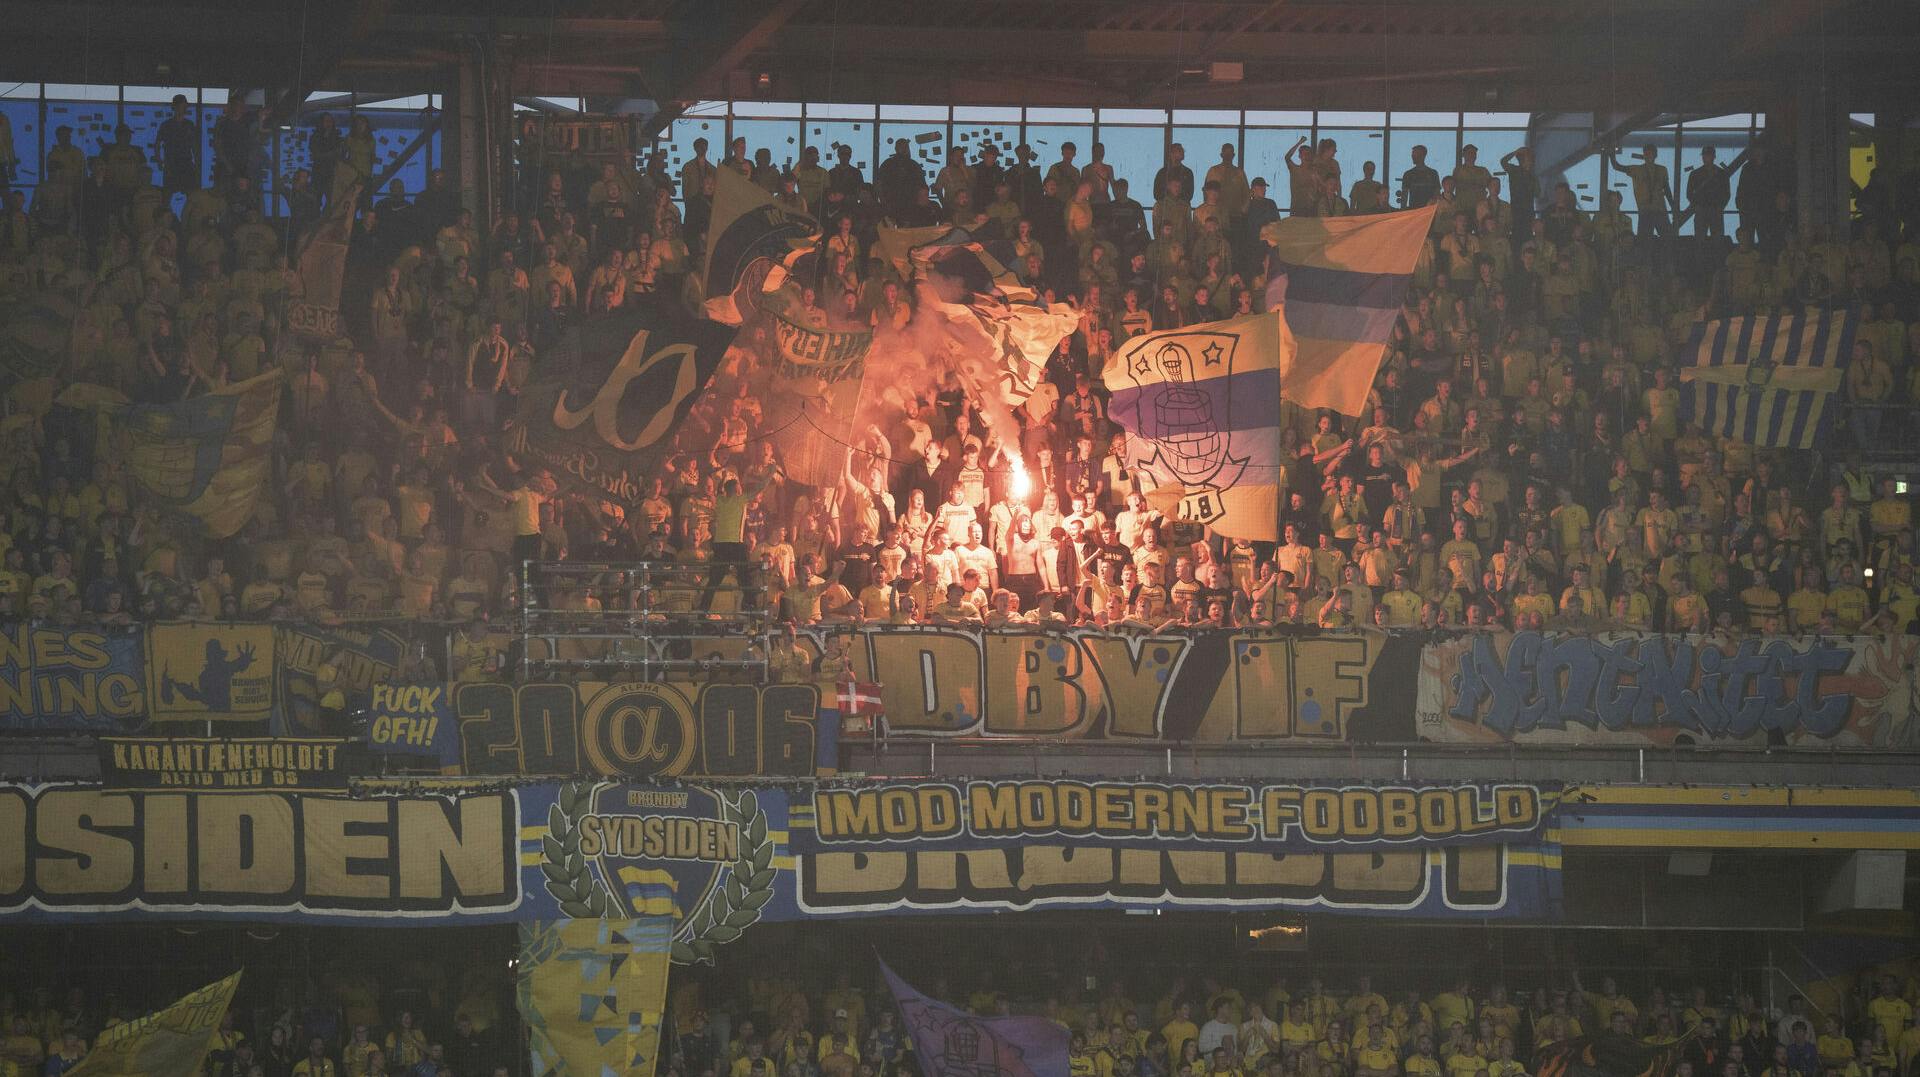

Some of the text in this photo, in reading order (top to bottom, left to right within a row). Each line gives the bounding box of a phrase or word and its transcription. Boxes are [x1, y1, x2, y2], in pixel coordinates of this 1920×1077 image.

[371, 683, 441, 714] FUCK
[620, 683, 659, 696] ALPHA
[1235, 637, 1369, 739] IF
[371, 714, 439, 747] GFH!
[113, 743, 337, 771] KARANTÆNEHOLDET
[223, 770, 263, 786] MED
[272, 770, 299, 785] OS
[815, 788, 958, 836] IMOD
[969, 784, 1250, 833] MODERNE
[0, 788, 506, 900] SIDEN
[578, 816, 739, 862] SYDSIDEN
